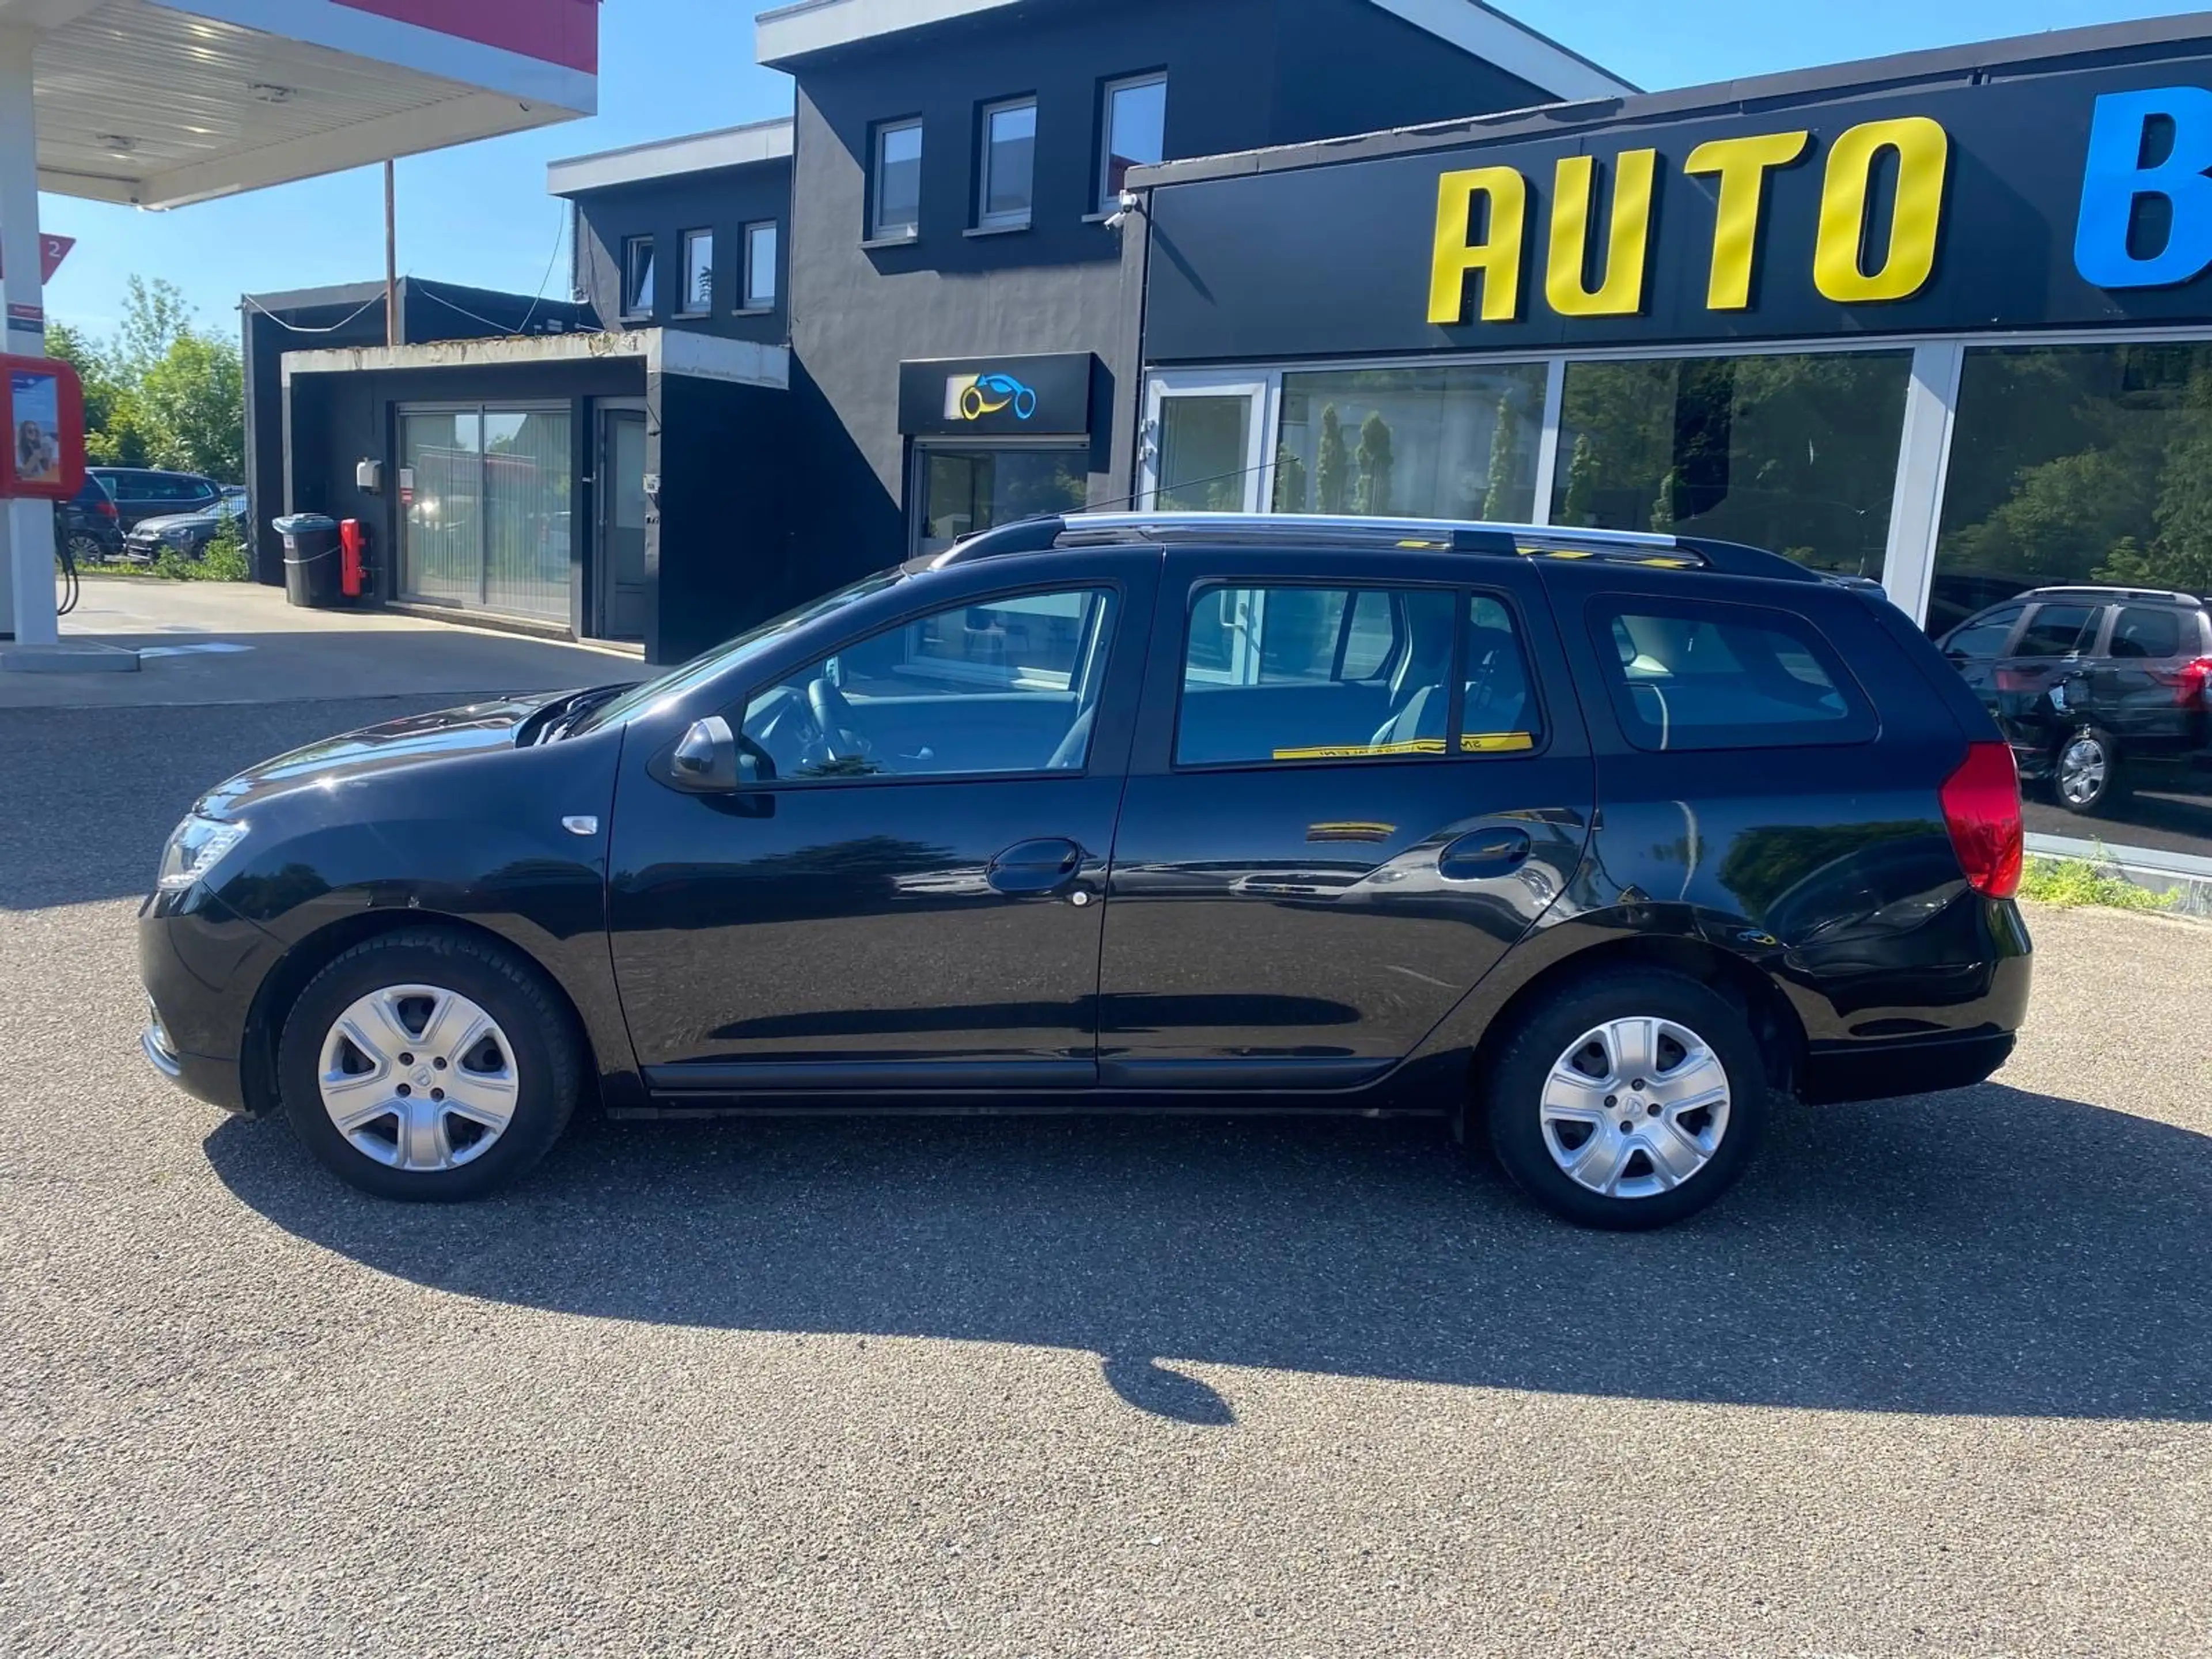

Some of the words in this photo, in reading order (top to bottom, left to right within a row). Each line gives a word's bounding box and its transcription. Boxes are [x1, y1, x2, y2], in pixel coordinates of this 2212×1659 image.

[48, 240, 60, 257] 2
[1427, 116, 1948, 324] AUTO
[2074, 86, 2212, 287] B
